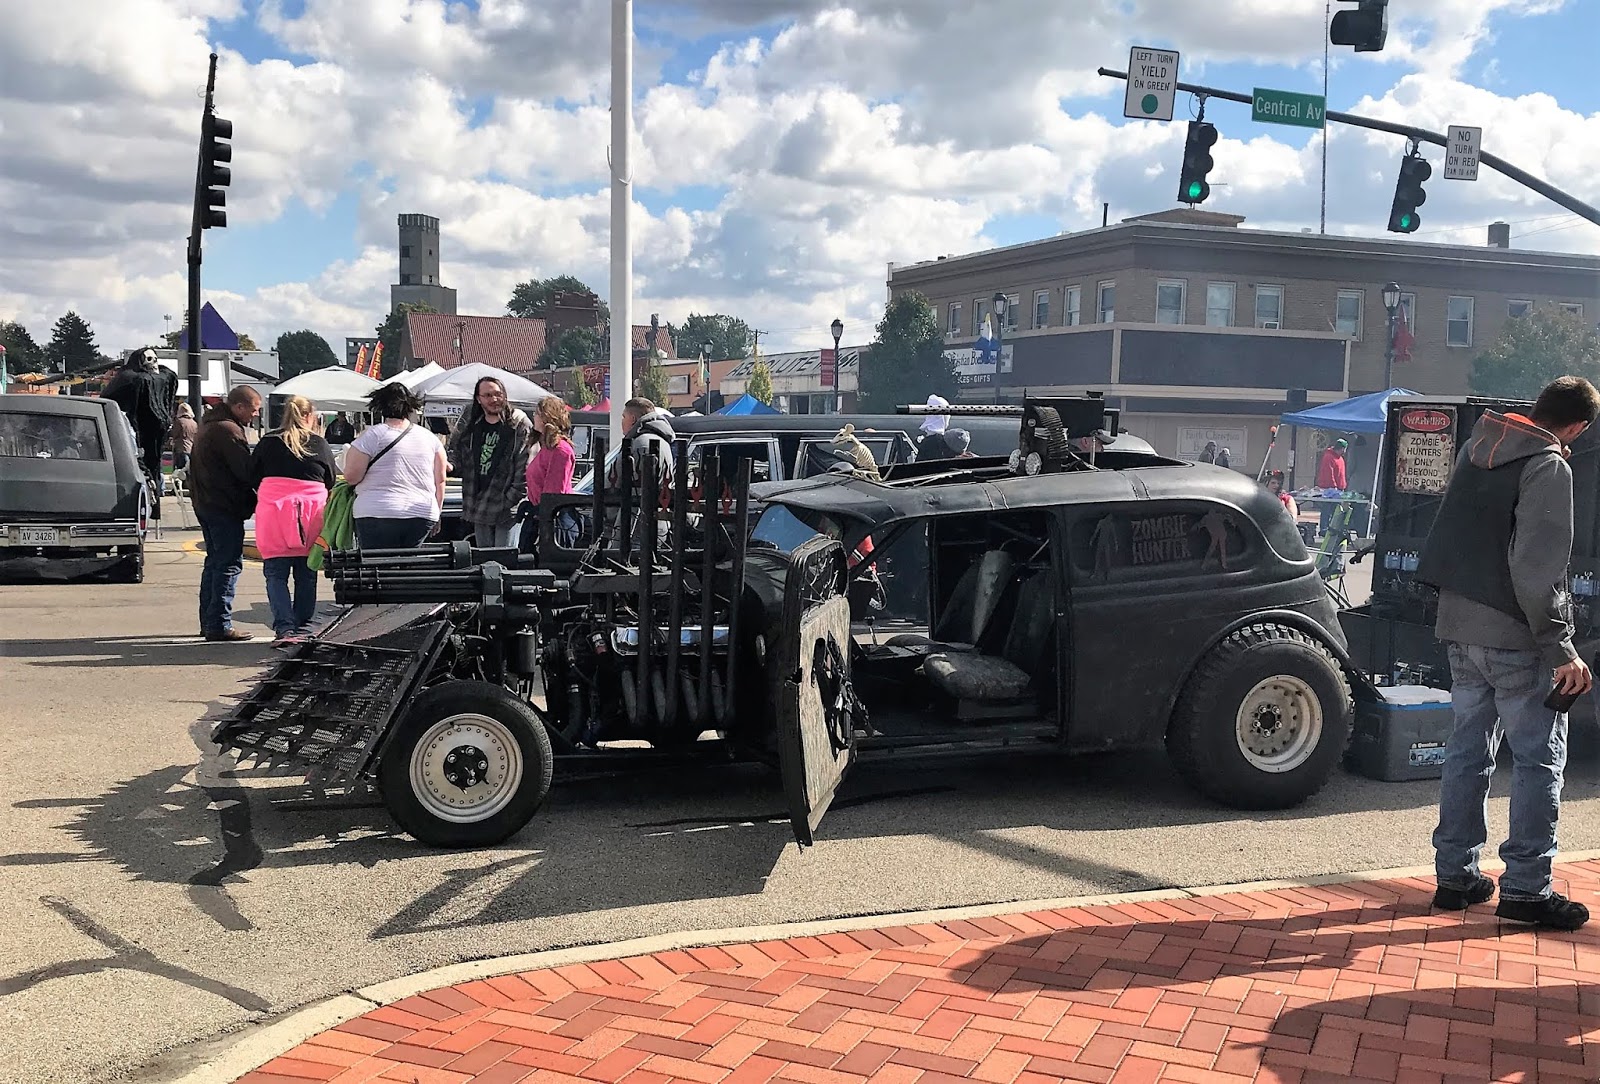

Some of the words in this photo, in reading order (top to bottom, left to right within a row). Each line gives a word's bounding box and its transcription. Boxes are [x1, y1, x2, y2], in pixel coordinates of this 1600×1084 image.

[1136, 52, 1152, 61] LEFT
[1157, 54, 1174, 64] TURN
[1141, 65, 1167, 78] YIELD
[1134, 79, 1144, 88] ON
[1147, 81, 1170, 91] GREEN
[1256, 96, 1300, 118] Central
[1306, 103, 1321, 120] Av
[1458, 131, 1471, 141] NO
[1455, 144, 1473, 154] TURN
[1448, 156, 1459, 165] ON
[1462, 157, 1476, 167] RED
[974, 375, 991, 383] GIFTS
[1407, 416, 1446, 426] WARNING
[1411, 437, 1440, 446] ZOMBIE
[1406, 447, 1442, 457] HUNTERS
[1414, 457, 1434, 467] ONLY
[1407, 467, 1438, 477] BEYOND
[1402, 478, 1420, 486] THIS
[1421, 478, 1443, 488] POINT
[1130, 514, 1187, 541] ZOMBIE
[22, 532, 31, 541] AV
[35, 532, 56, 541] 34261
[1132, 538, 1191, 564] HUNTER
